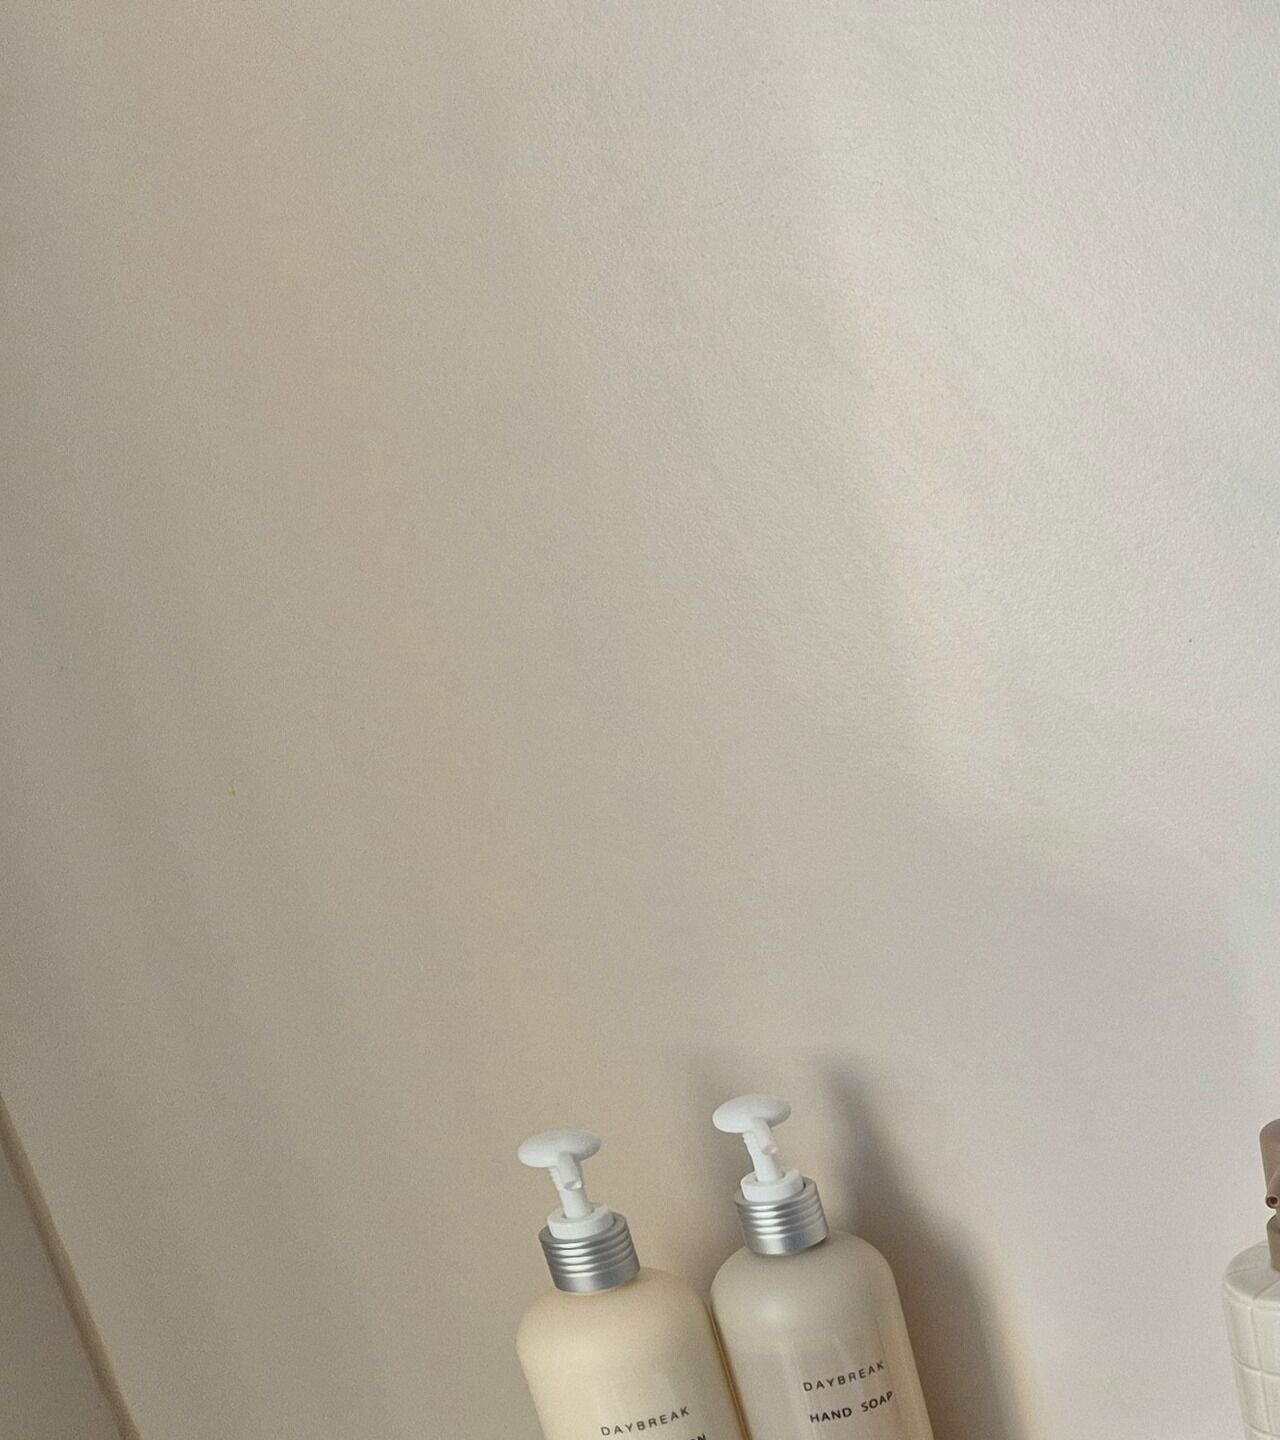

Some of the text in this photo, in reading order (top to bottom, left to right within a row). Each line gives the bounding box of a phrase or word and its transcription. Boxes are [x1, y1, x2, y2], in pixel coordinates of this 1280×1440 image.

[803, 1361, 885, 1392] DAYBREAK
[601, 1406, 690, 1436] DAYBREAK
[809, 1391, 893, 1423] HAND SOAP
